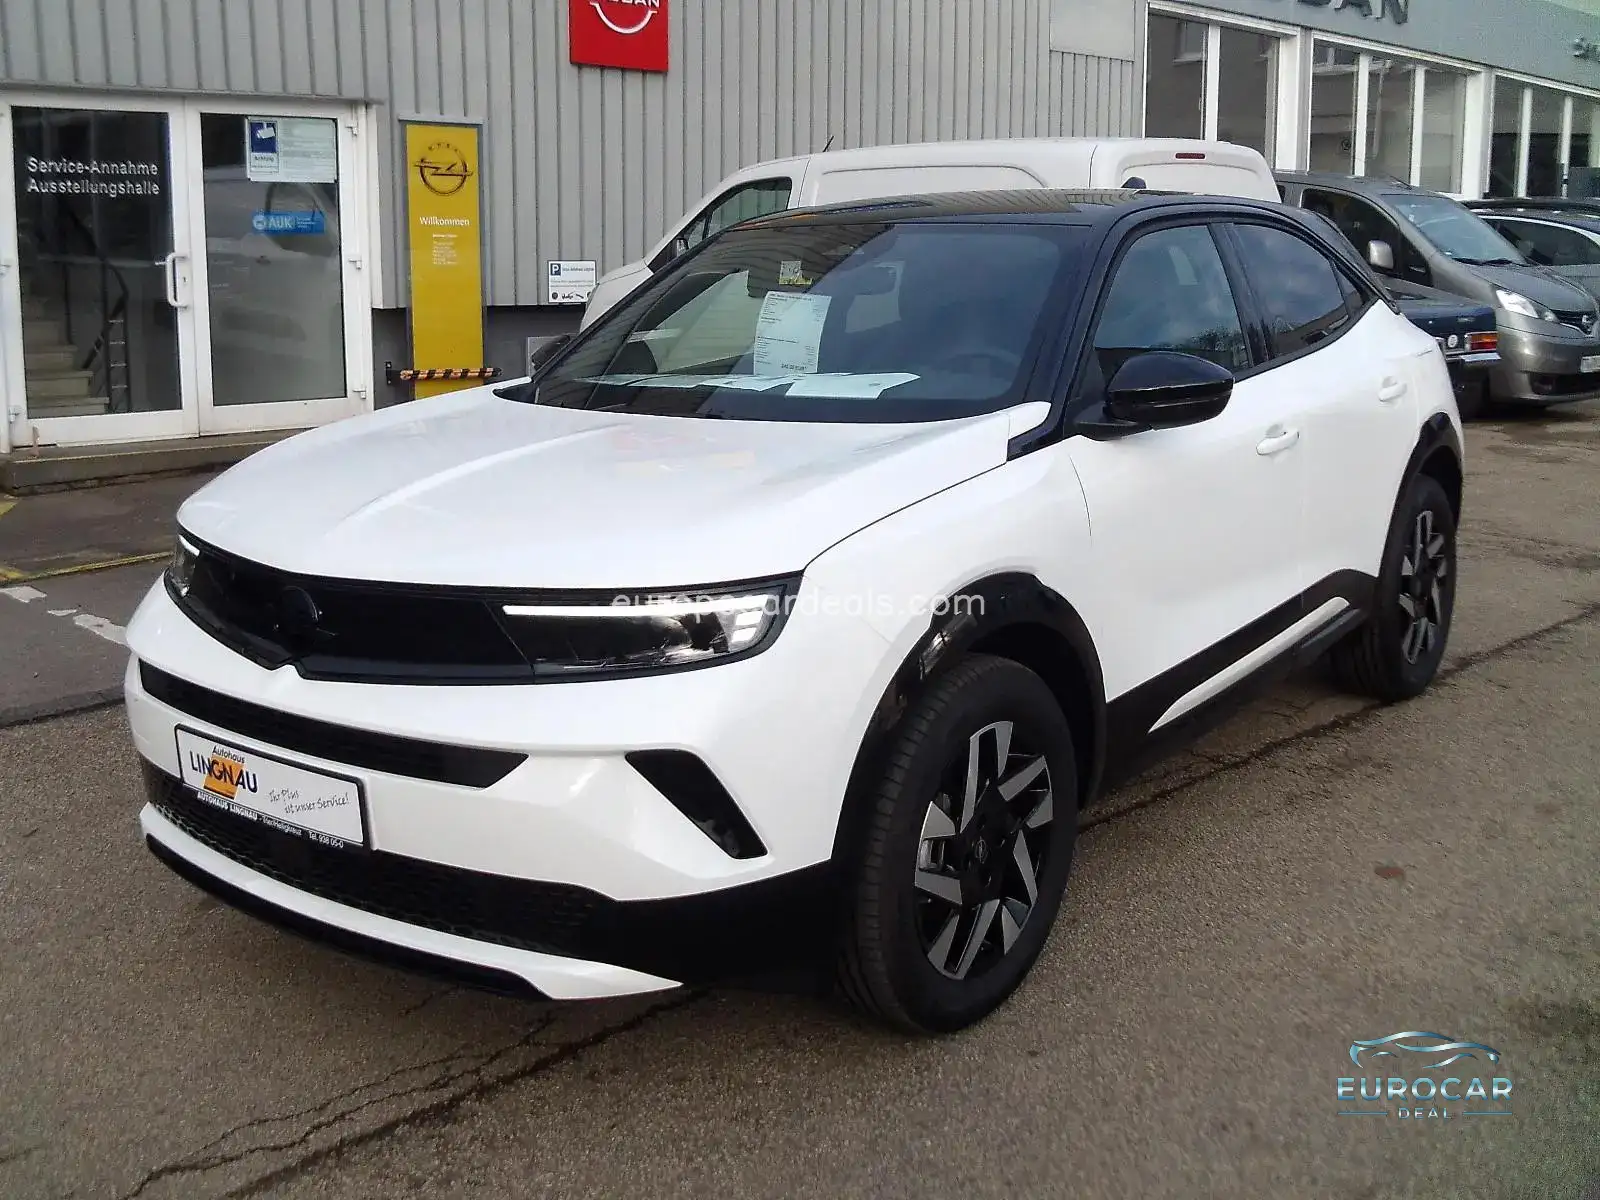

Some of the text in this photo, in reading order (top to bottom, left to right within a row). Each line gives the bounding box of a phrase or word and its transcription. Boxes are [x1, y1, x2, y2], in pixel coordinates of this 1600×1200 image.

[27, 156, 159, 175] Service-Annahme
[27, 178, 160, 198] Ausstellungshalle
[419, 215, 471, 227] Willkommen
[212, 745, 246, 764] Autohaus
[189, 750, 258, 793] LINGNAU
